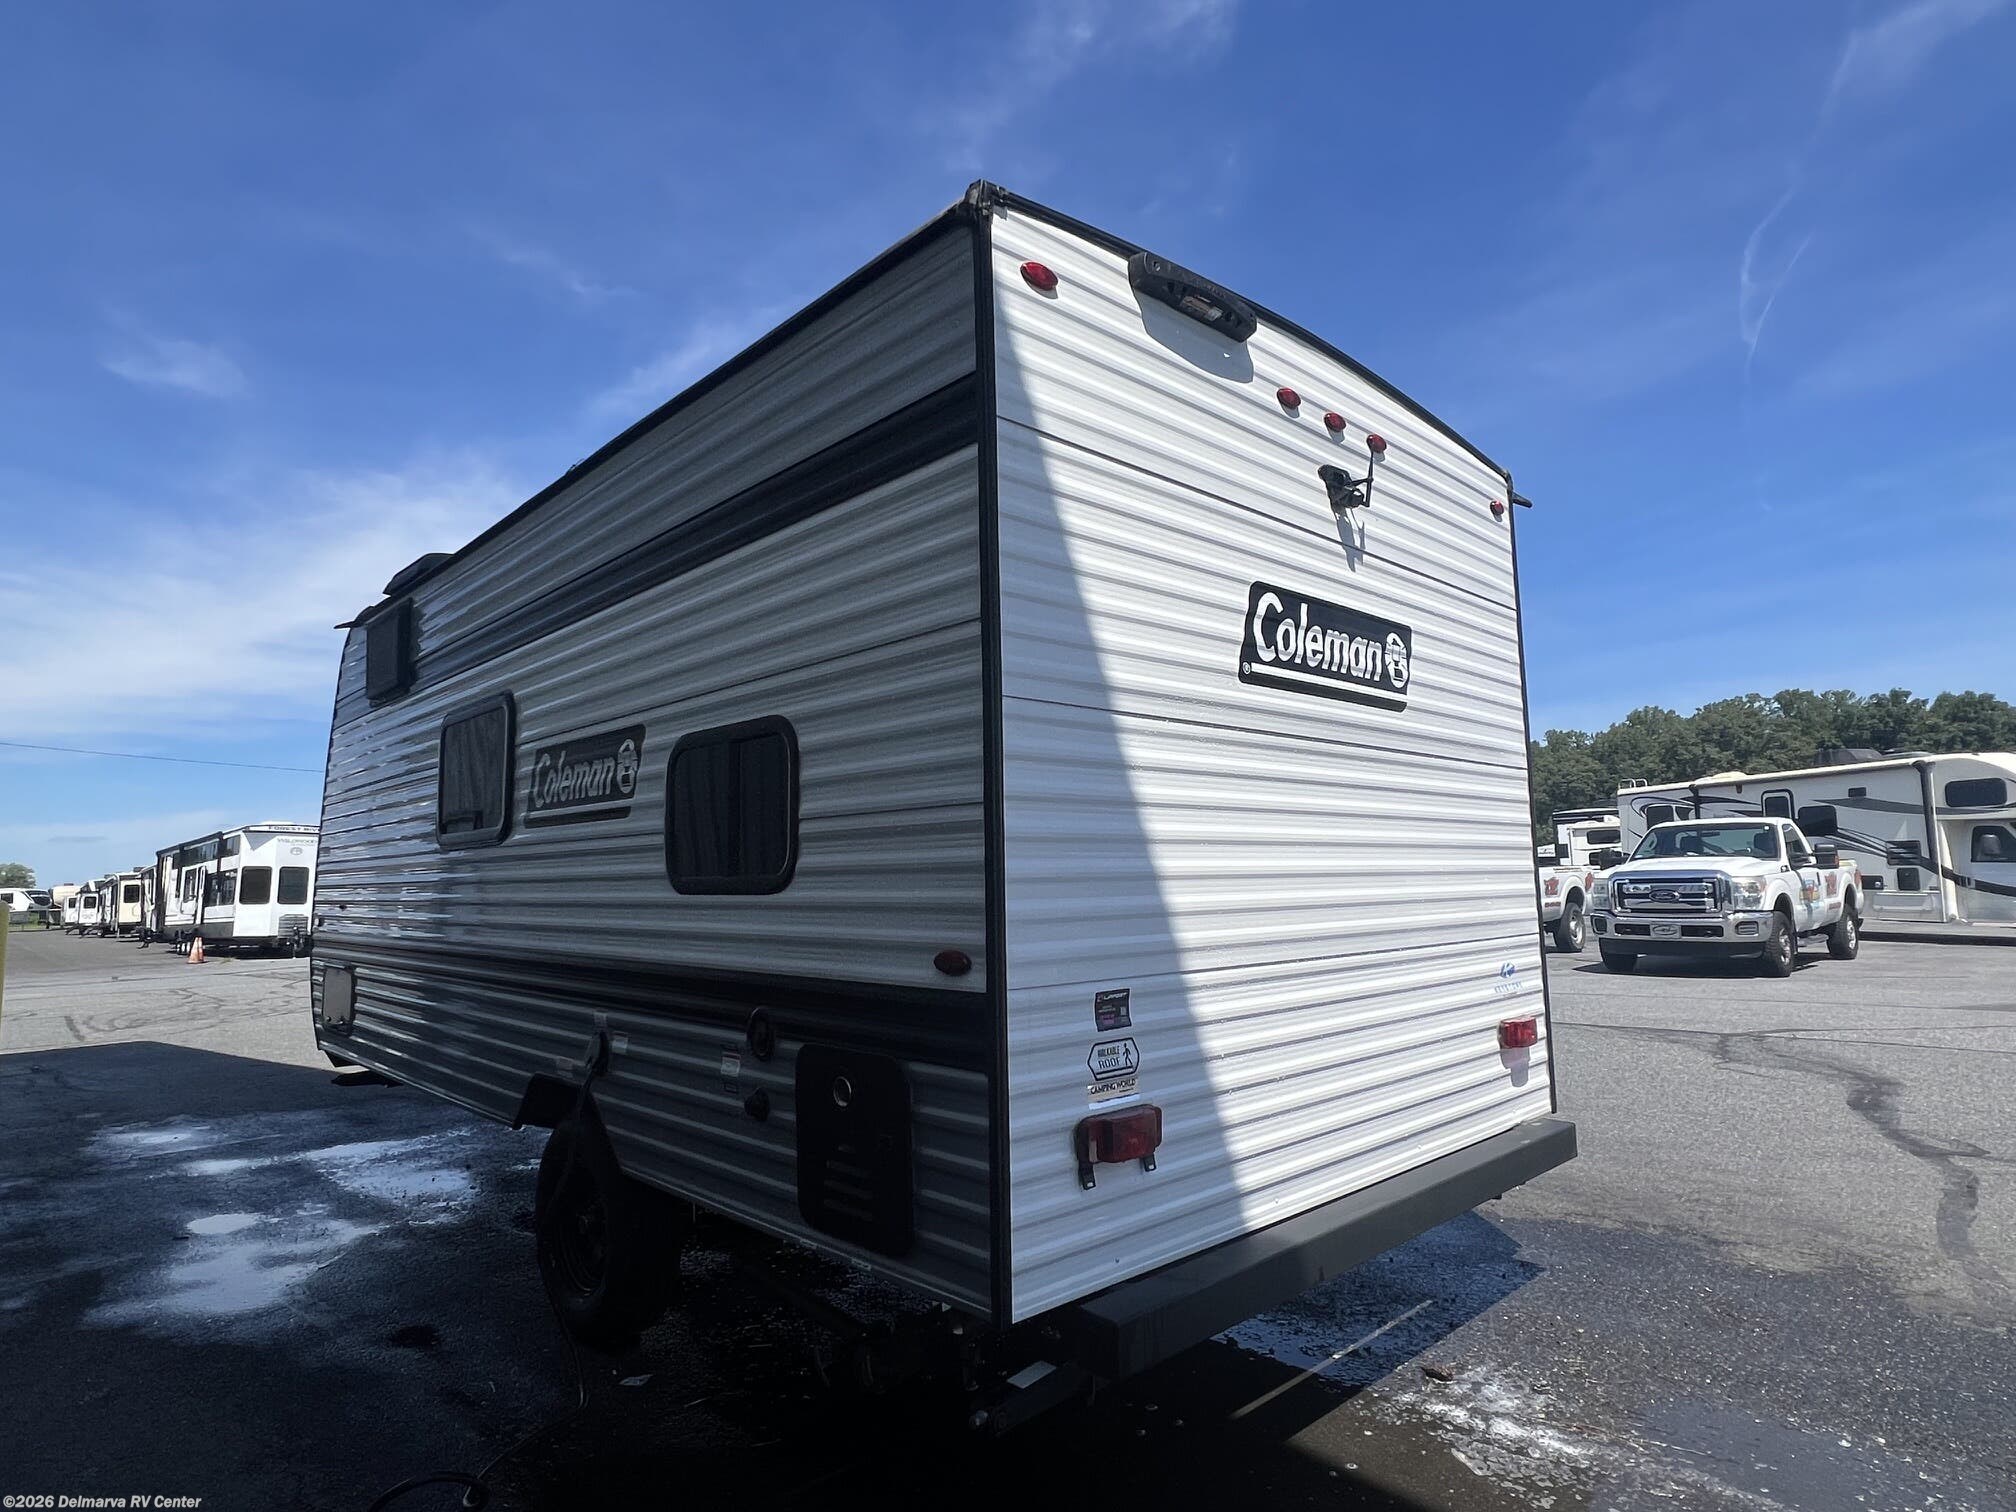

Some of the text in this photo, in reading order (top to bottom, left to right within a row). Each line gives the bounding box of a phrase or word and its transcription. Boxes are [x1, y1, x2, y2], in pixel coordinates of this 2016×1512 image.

[1253, 591, 1383, 682] Coleman
[533, 750, 616, 808] Coleman
[1098, 1057, 1120, 1069] ROOF
[1090, 1082, 1116, 1095] CAMPING
[1116, 1078, 1136, 1089] WORLD
